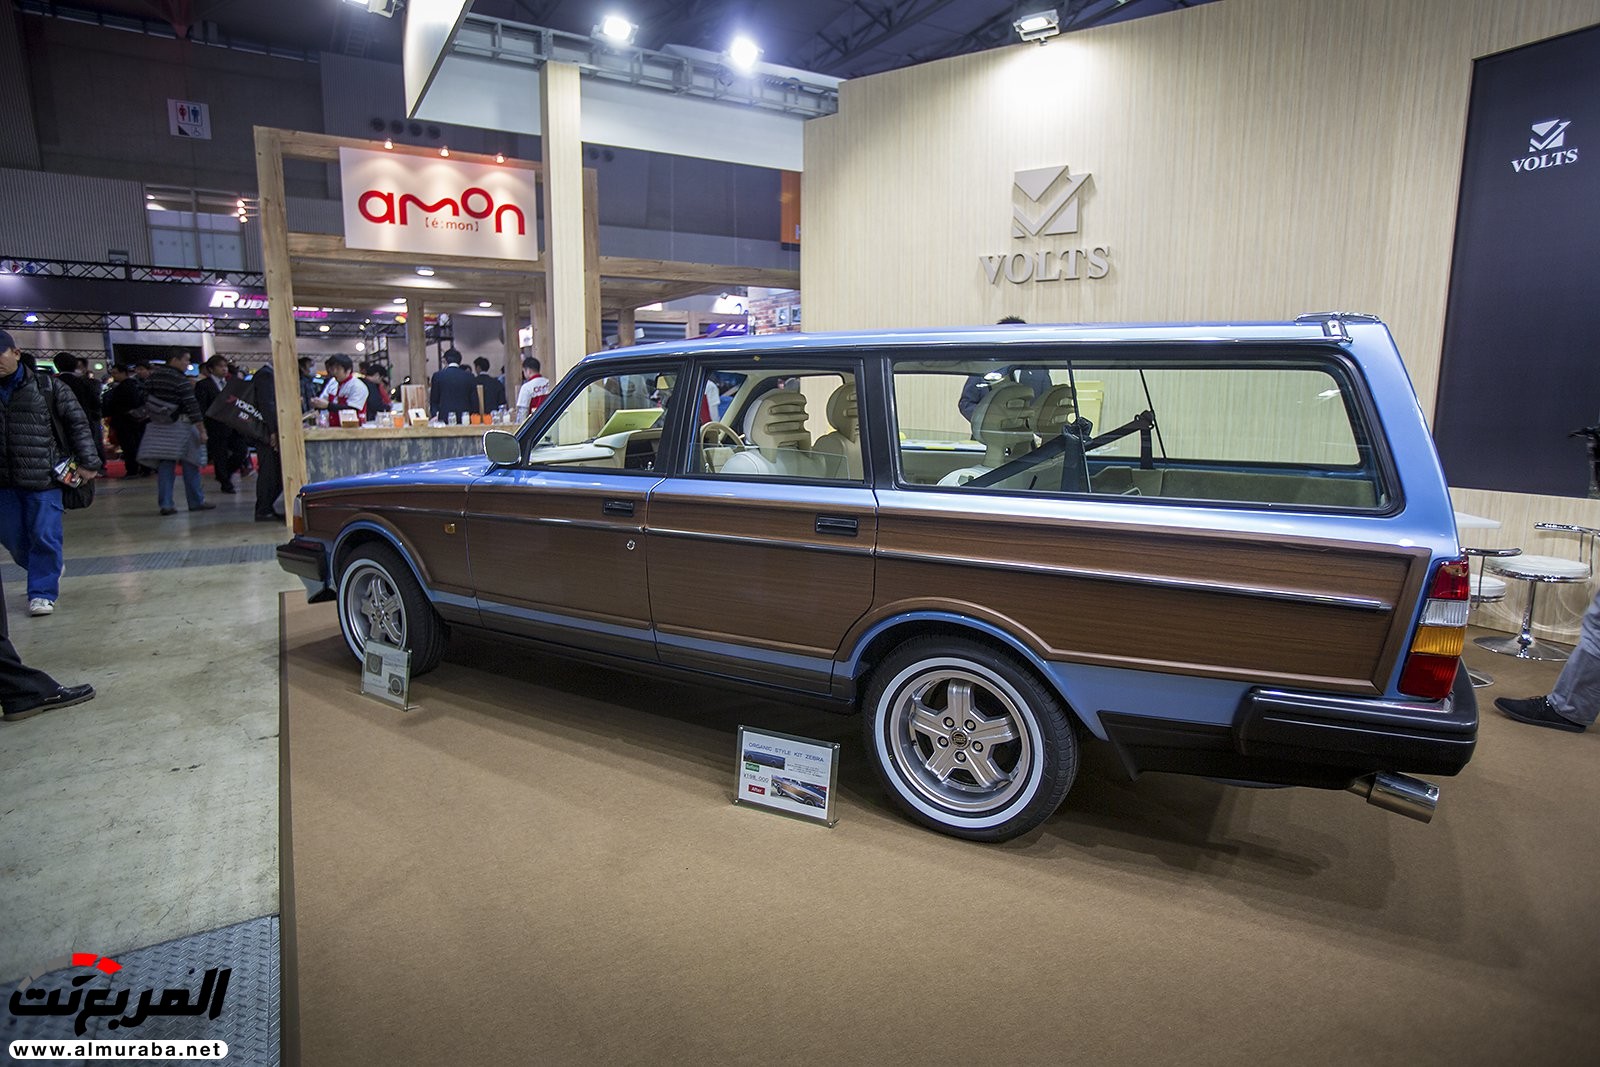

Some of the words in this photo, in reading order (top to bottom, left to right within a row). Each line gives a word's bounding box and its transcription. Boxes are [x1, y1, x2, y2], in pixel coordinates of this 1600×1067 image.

[1511, 148, 1579, 173] VOLTS
[358, 187, 525, 236] amon
[979, 246, 1110, 285] VOLTS
[748, 742, 772, 751] ORGANIC
[805, 754, 824, 762] ZEBRA
